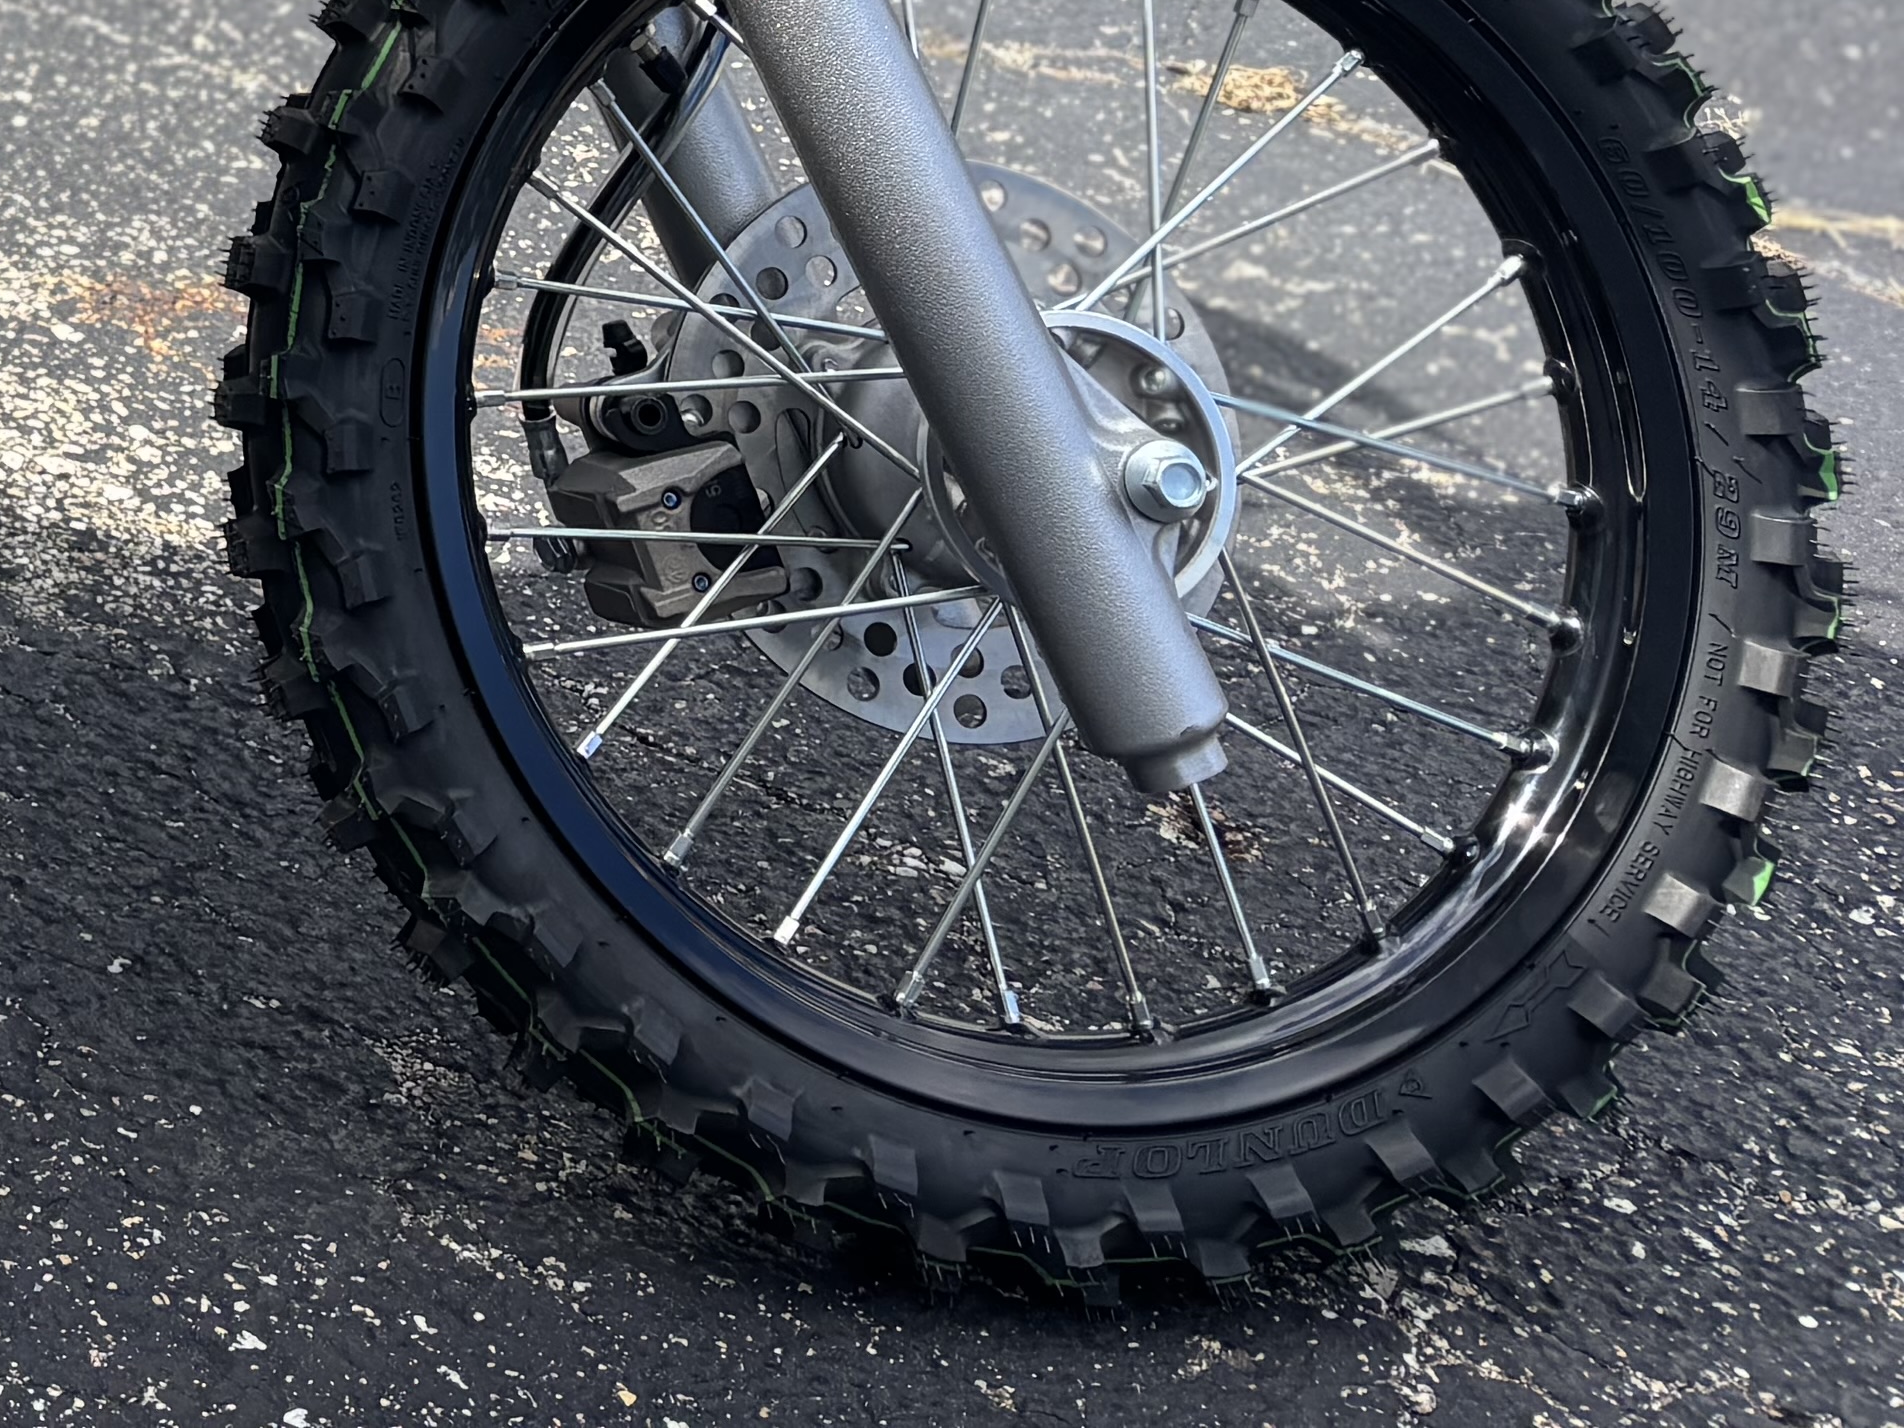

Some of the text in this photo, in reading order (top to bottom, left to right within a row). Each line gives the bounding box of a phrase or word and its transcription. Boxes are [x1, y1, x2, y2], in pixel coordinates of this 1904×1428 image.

[1595, 640, 1733, 927] NOT FOR HIGHWAY SERVICE
[1070, 1081, 1397, 1181] DUNLOP
